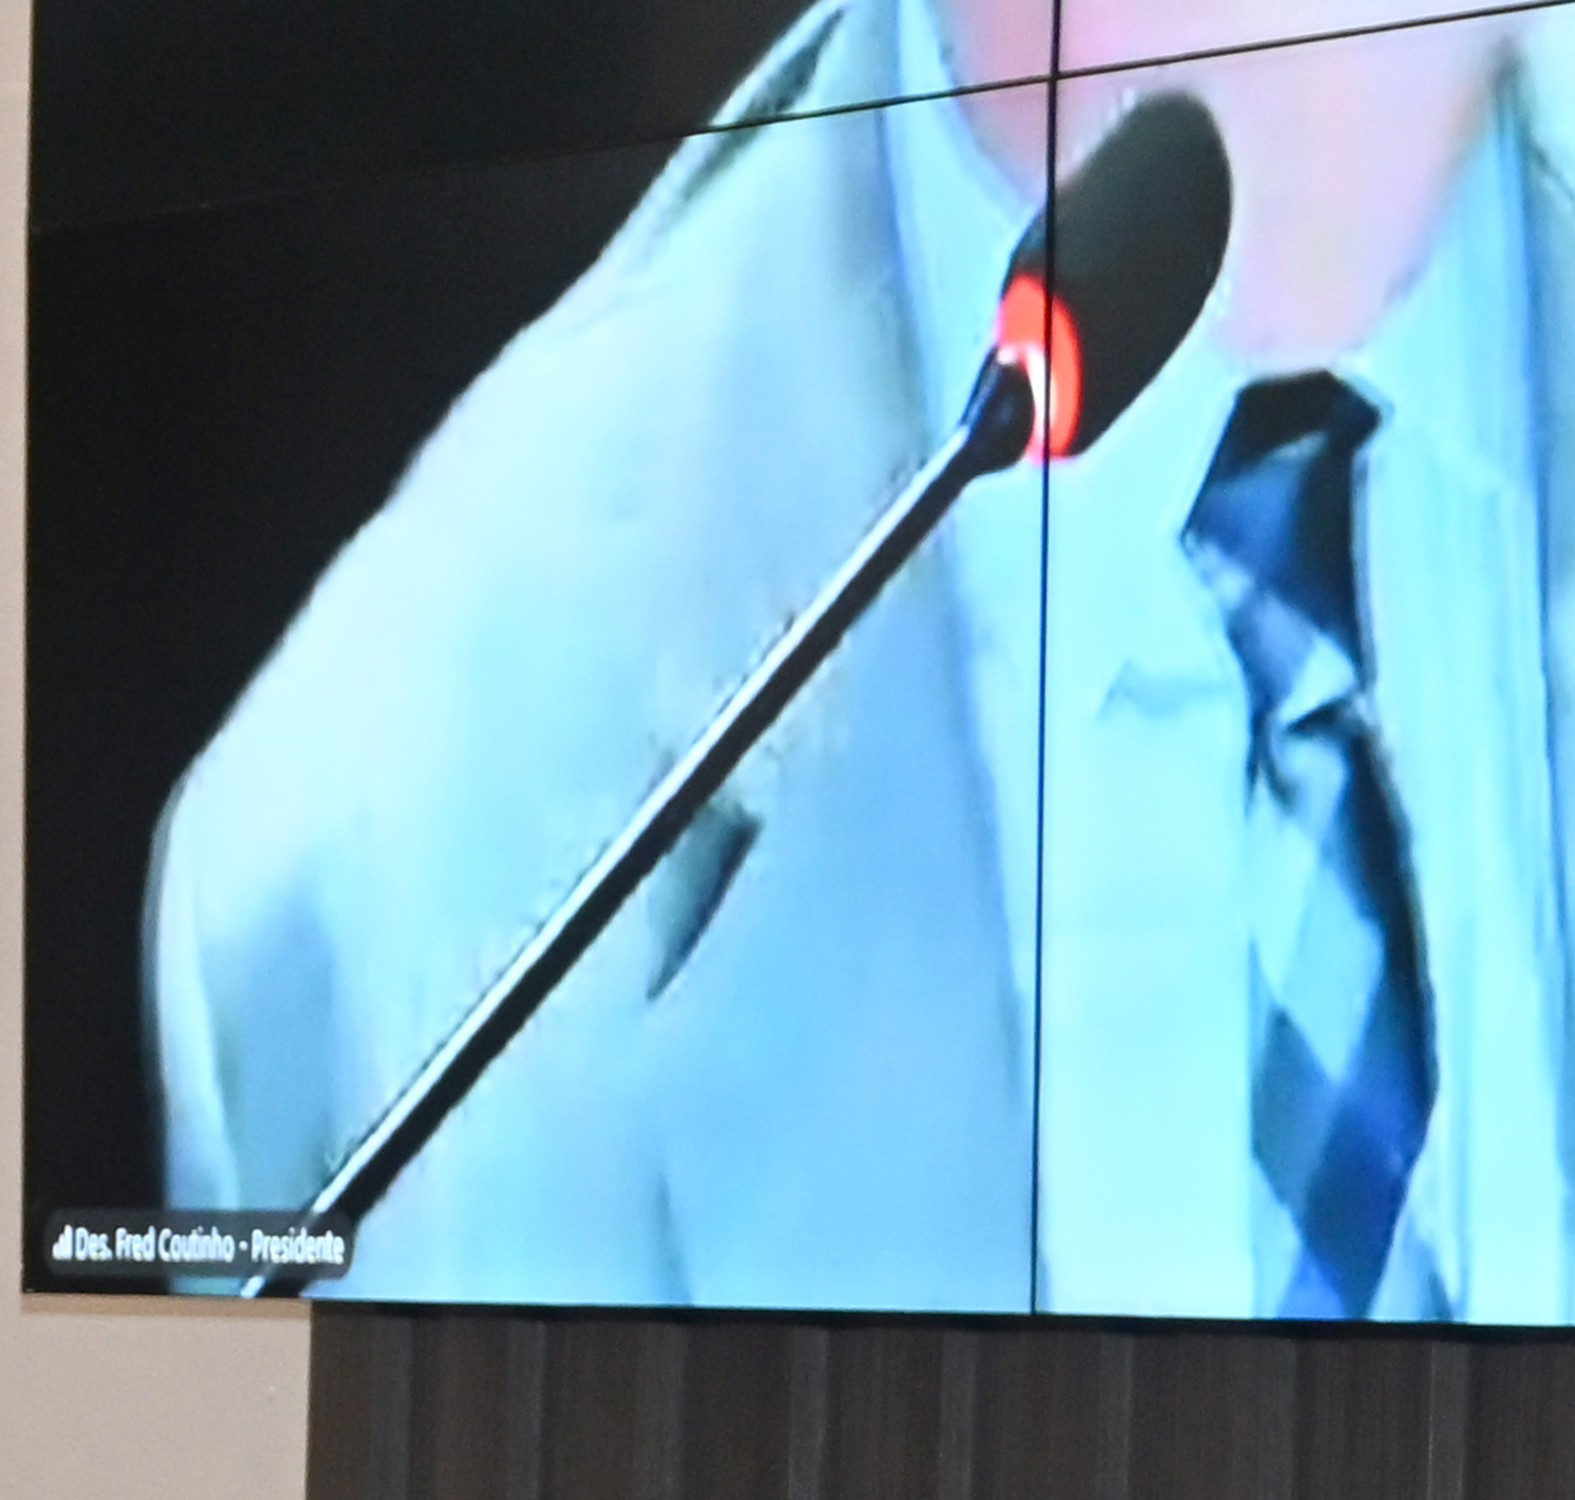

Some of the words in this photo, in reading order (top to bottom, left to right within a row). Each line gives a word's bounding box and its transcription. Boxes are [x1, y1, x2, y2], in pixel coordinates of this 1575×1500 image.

[75, 1227, 113, 1260] Des.
[116, 1226, 156, 1260] Fred
[159, 1226, 235, 1262] Coutinho
[251, 1228, 345, 1264] Presidente
